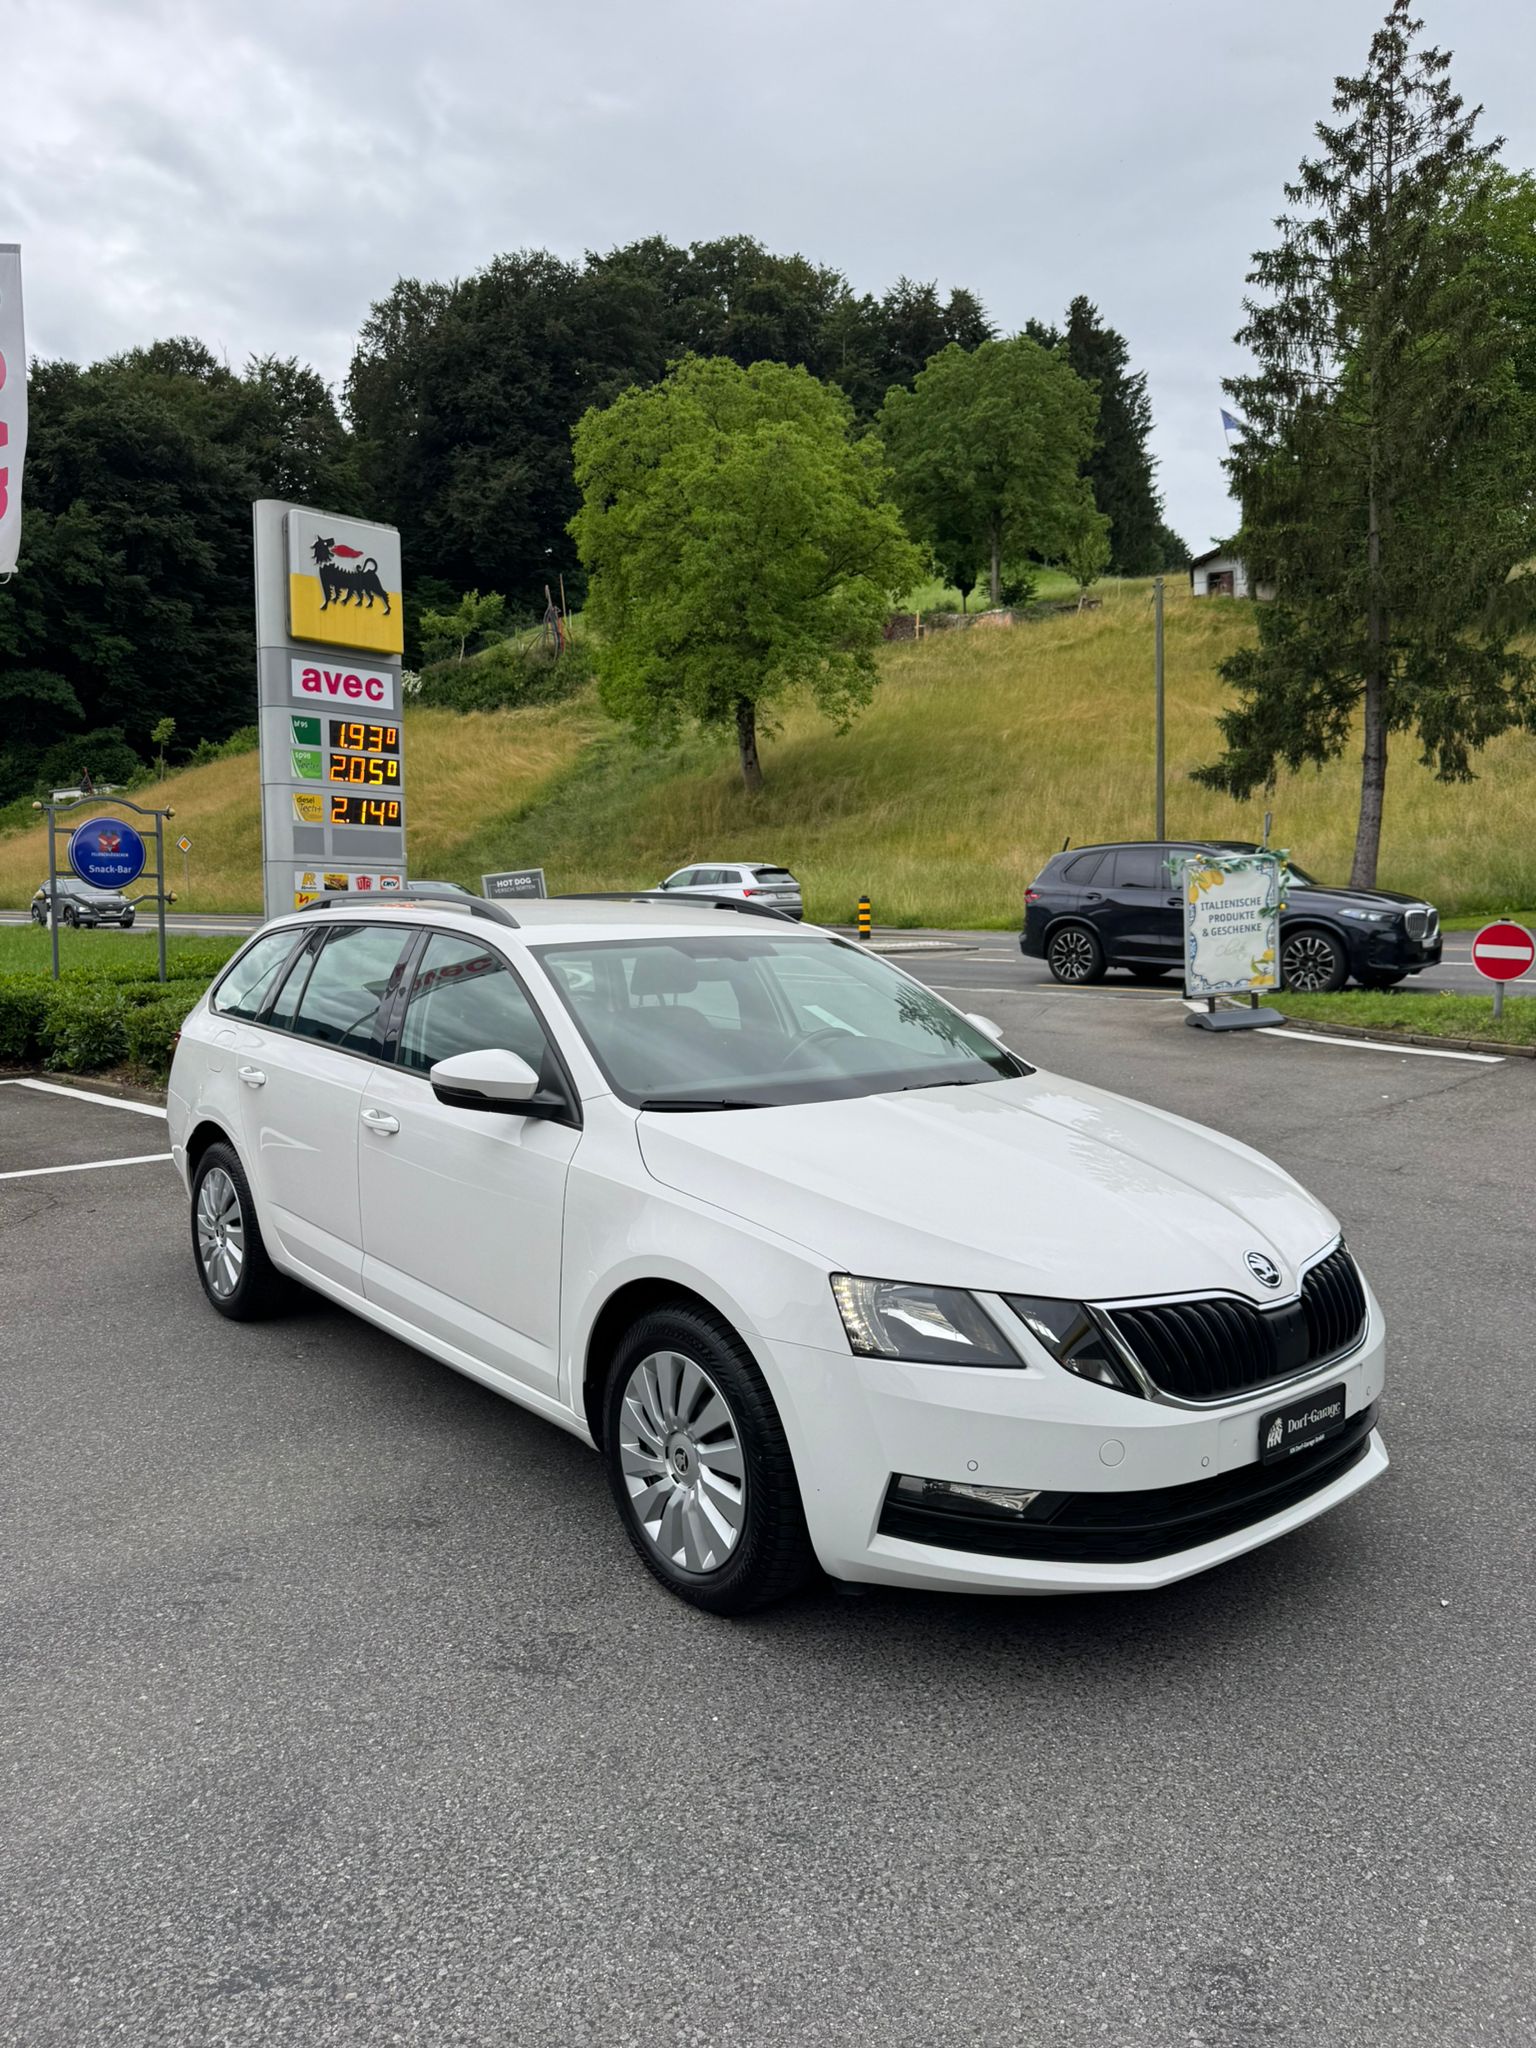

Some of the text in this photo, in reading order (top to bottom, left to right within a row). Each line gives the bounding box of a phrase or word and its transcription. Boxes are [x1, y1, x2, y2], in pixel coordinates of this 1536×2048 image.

[302, 668, 384, 702] avec
[89, 865, 132, 873] Snack-Bar
[496, 877, 532, 888] HOT DOG
[1200, 896, 1262, 911] ITALIENISCHE
[1208, 910, 1256, 924] PRODUKTE
[1202, 922, 1263, 937] & GESCHENKE
[1288, 1402, 1341, 1433] Dorf-Garage
